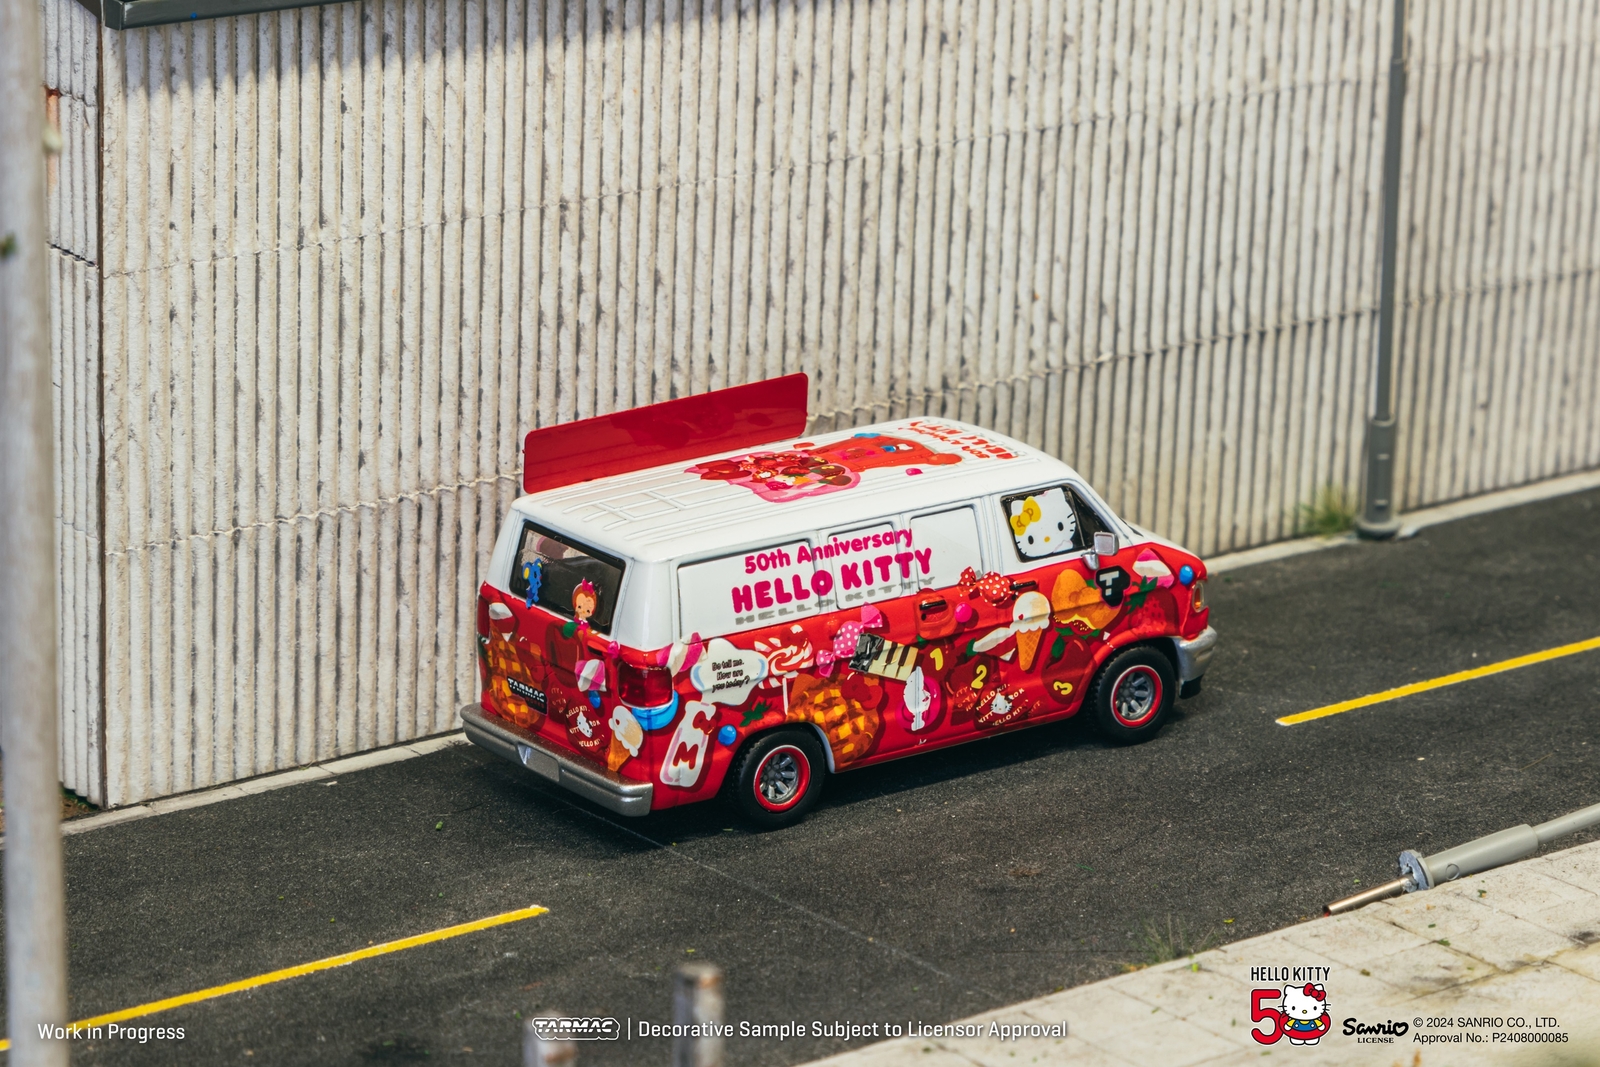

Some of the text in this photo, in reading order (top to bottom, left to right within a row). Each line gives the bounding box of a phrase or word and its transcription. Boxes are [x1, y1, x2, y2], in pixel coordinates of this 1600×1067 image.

[745, 528, 912, 575] 50th Anniversary
[731, 547, 932, 613] HELLO KITTY
[929, 647, 944, 672] 1
[711, 674, 751, 693] you today?
[716, 669, 744, 681] How are
[971, 664, 988, 689] 2
[507, 677, 545, 703] TARMAC
[1053, 681, 1073, 695] 3
[672, 741, 699, 770] M
